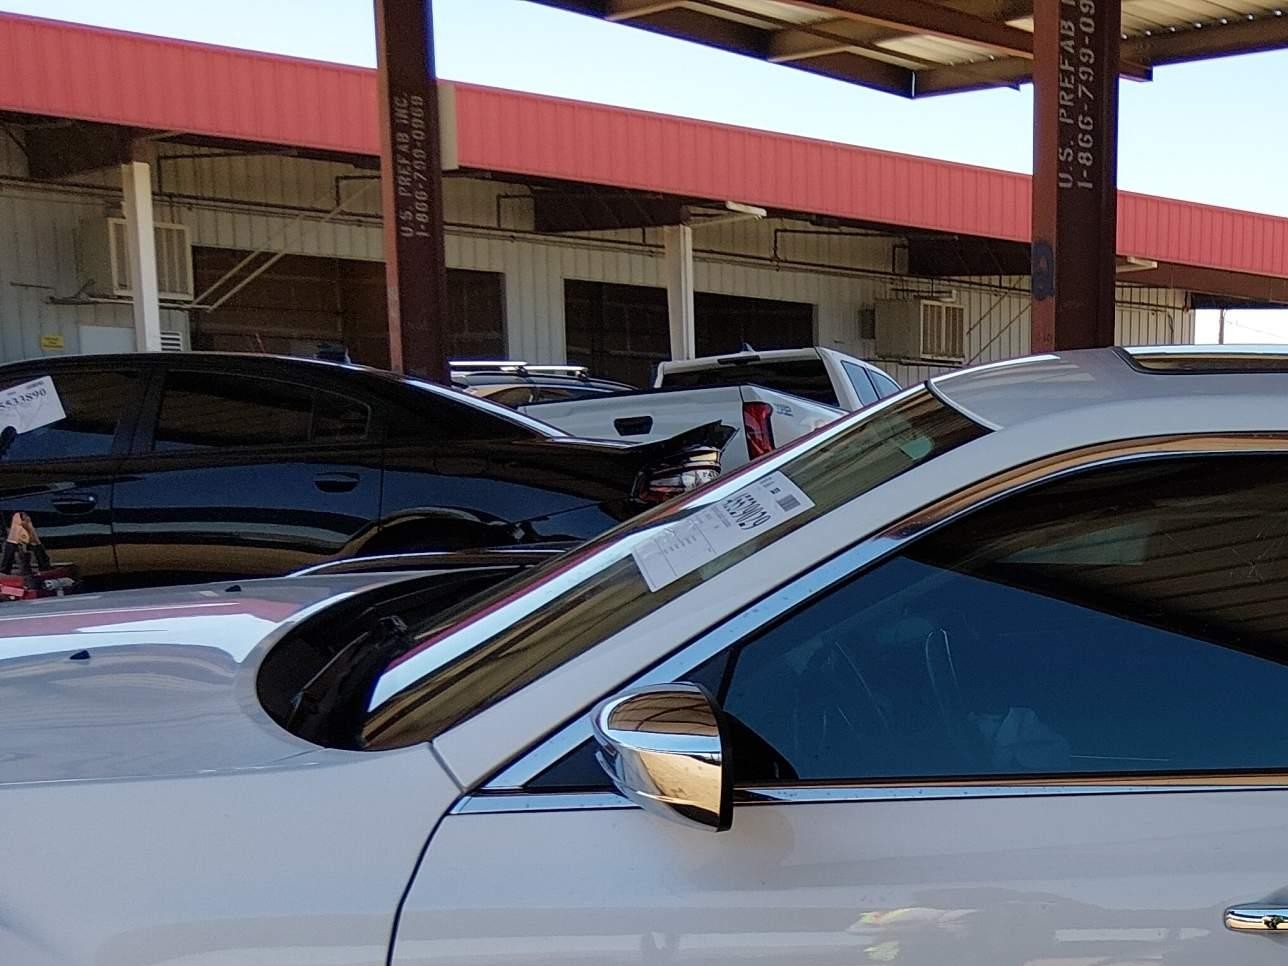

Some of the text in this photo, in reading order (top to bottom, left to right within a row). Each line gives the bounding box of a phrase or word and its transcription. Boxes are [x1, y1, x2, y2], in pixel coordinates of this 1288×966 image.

[1058, 19, 1076, 124] PREFAB
[396, 132, 413, 197] PREFAB
[1058, 140, 1074, 189] U.S.
